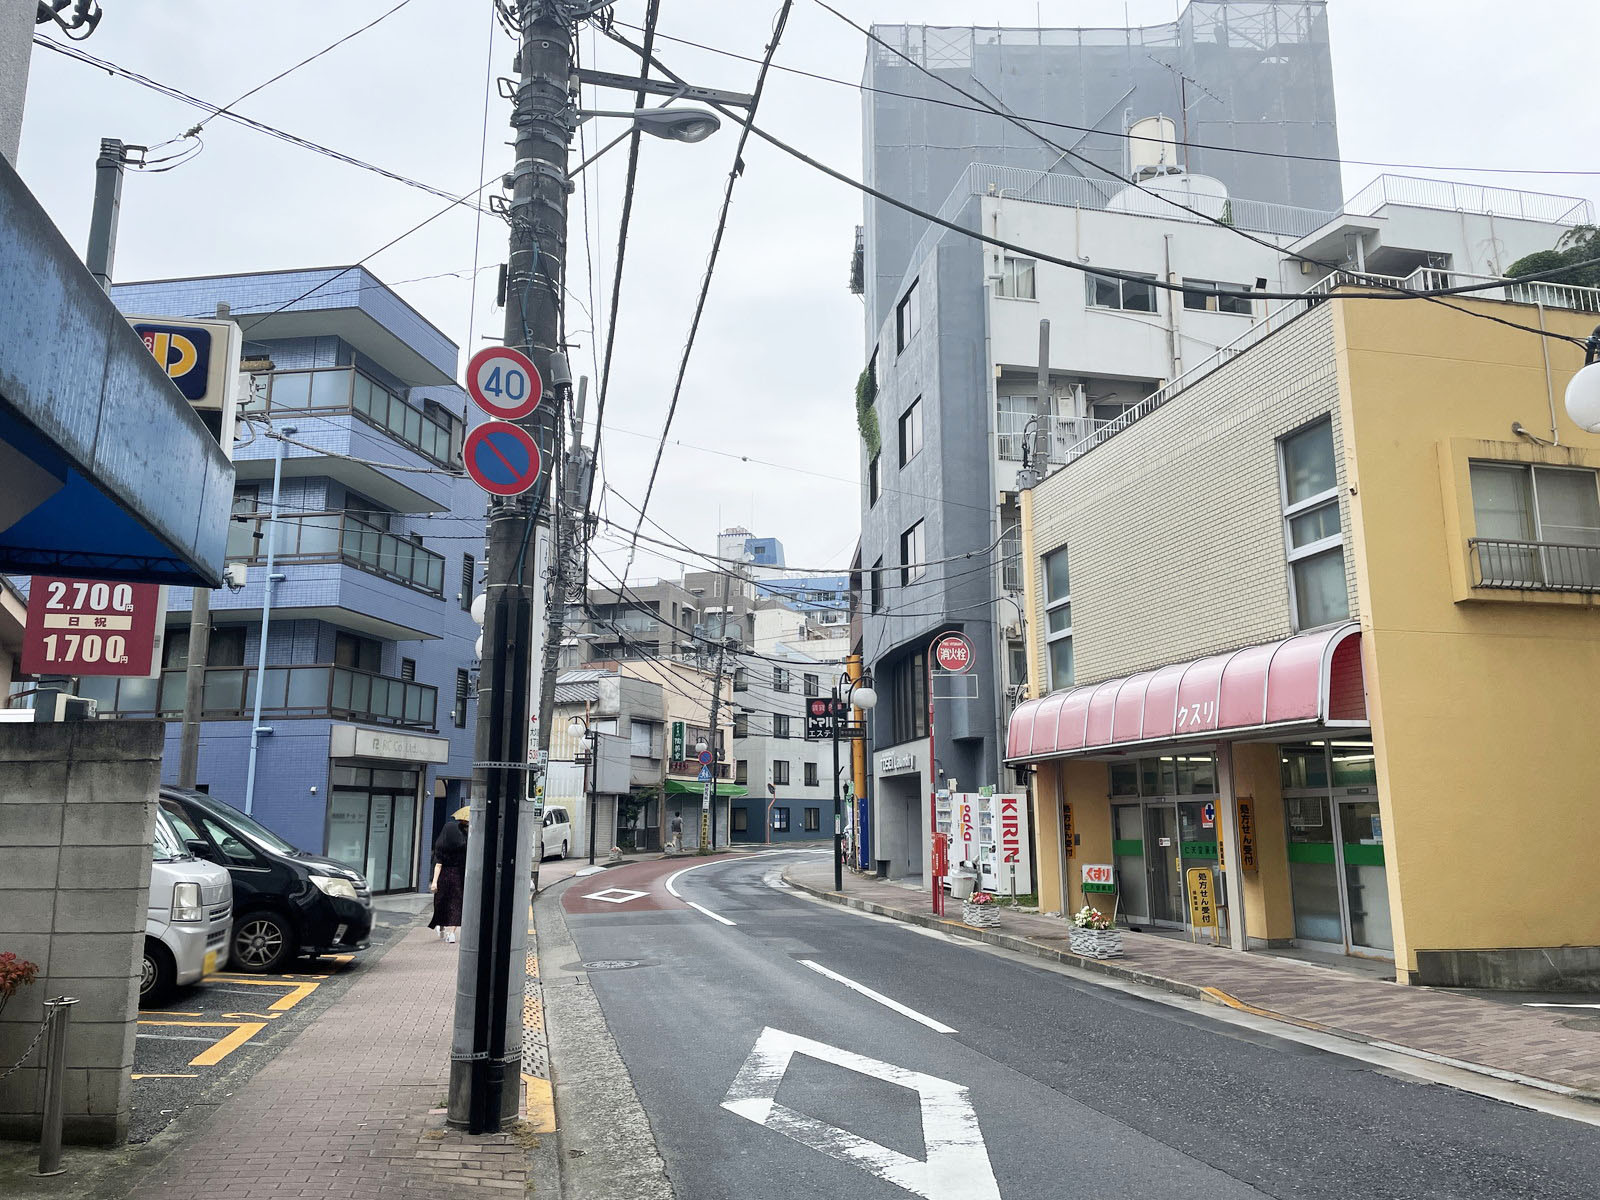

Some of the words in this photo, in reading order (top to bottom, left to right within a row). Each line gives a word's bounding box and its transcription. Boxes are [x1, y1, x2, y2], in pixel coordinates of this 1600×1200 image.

[484, 366, 525, 401] 40
[940, 647, 967, 661] 消火栓
[1177, 701, 1214, 728] クスリ
[962, 804, 974, 842] DyDo
[1001, 798, 1020, 863] KIRIN
[1240, 804, 1254, 866] 処方せん受付
[1086, 867, 1111, 882] くすり
[1198, 872, 1211, 924] 処方せん受付
